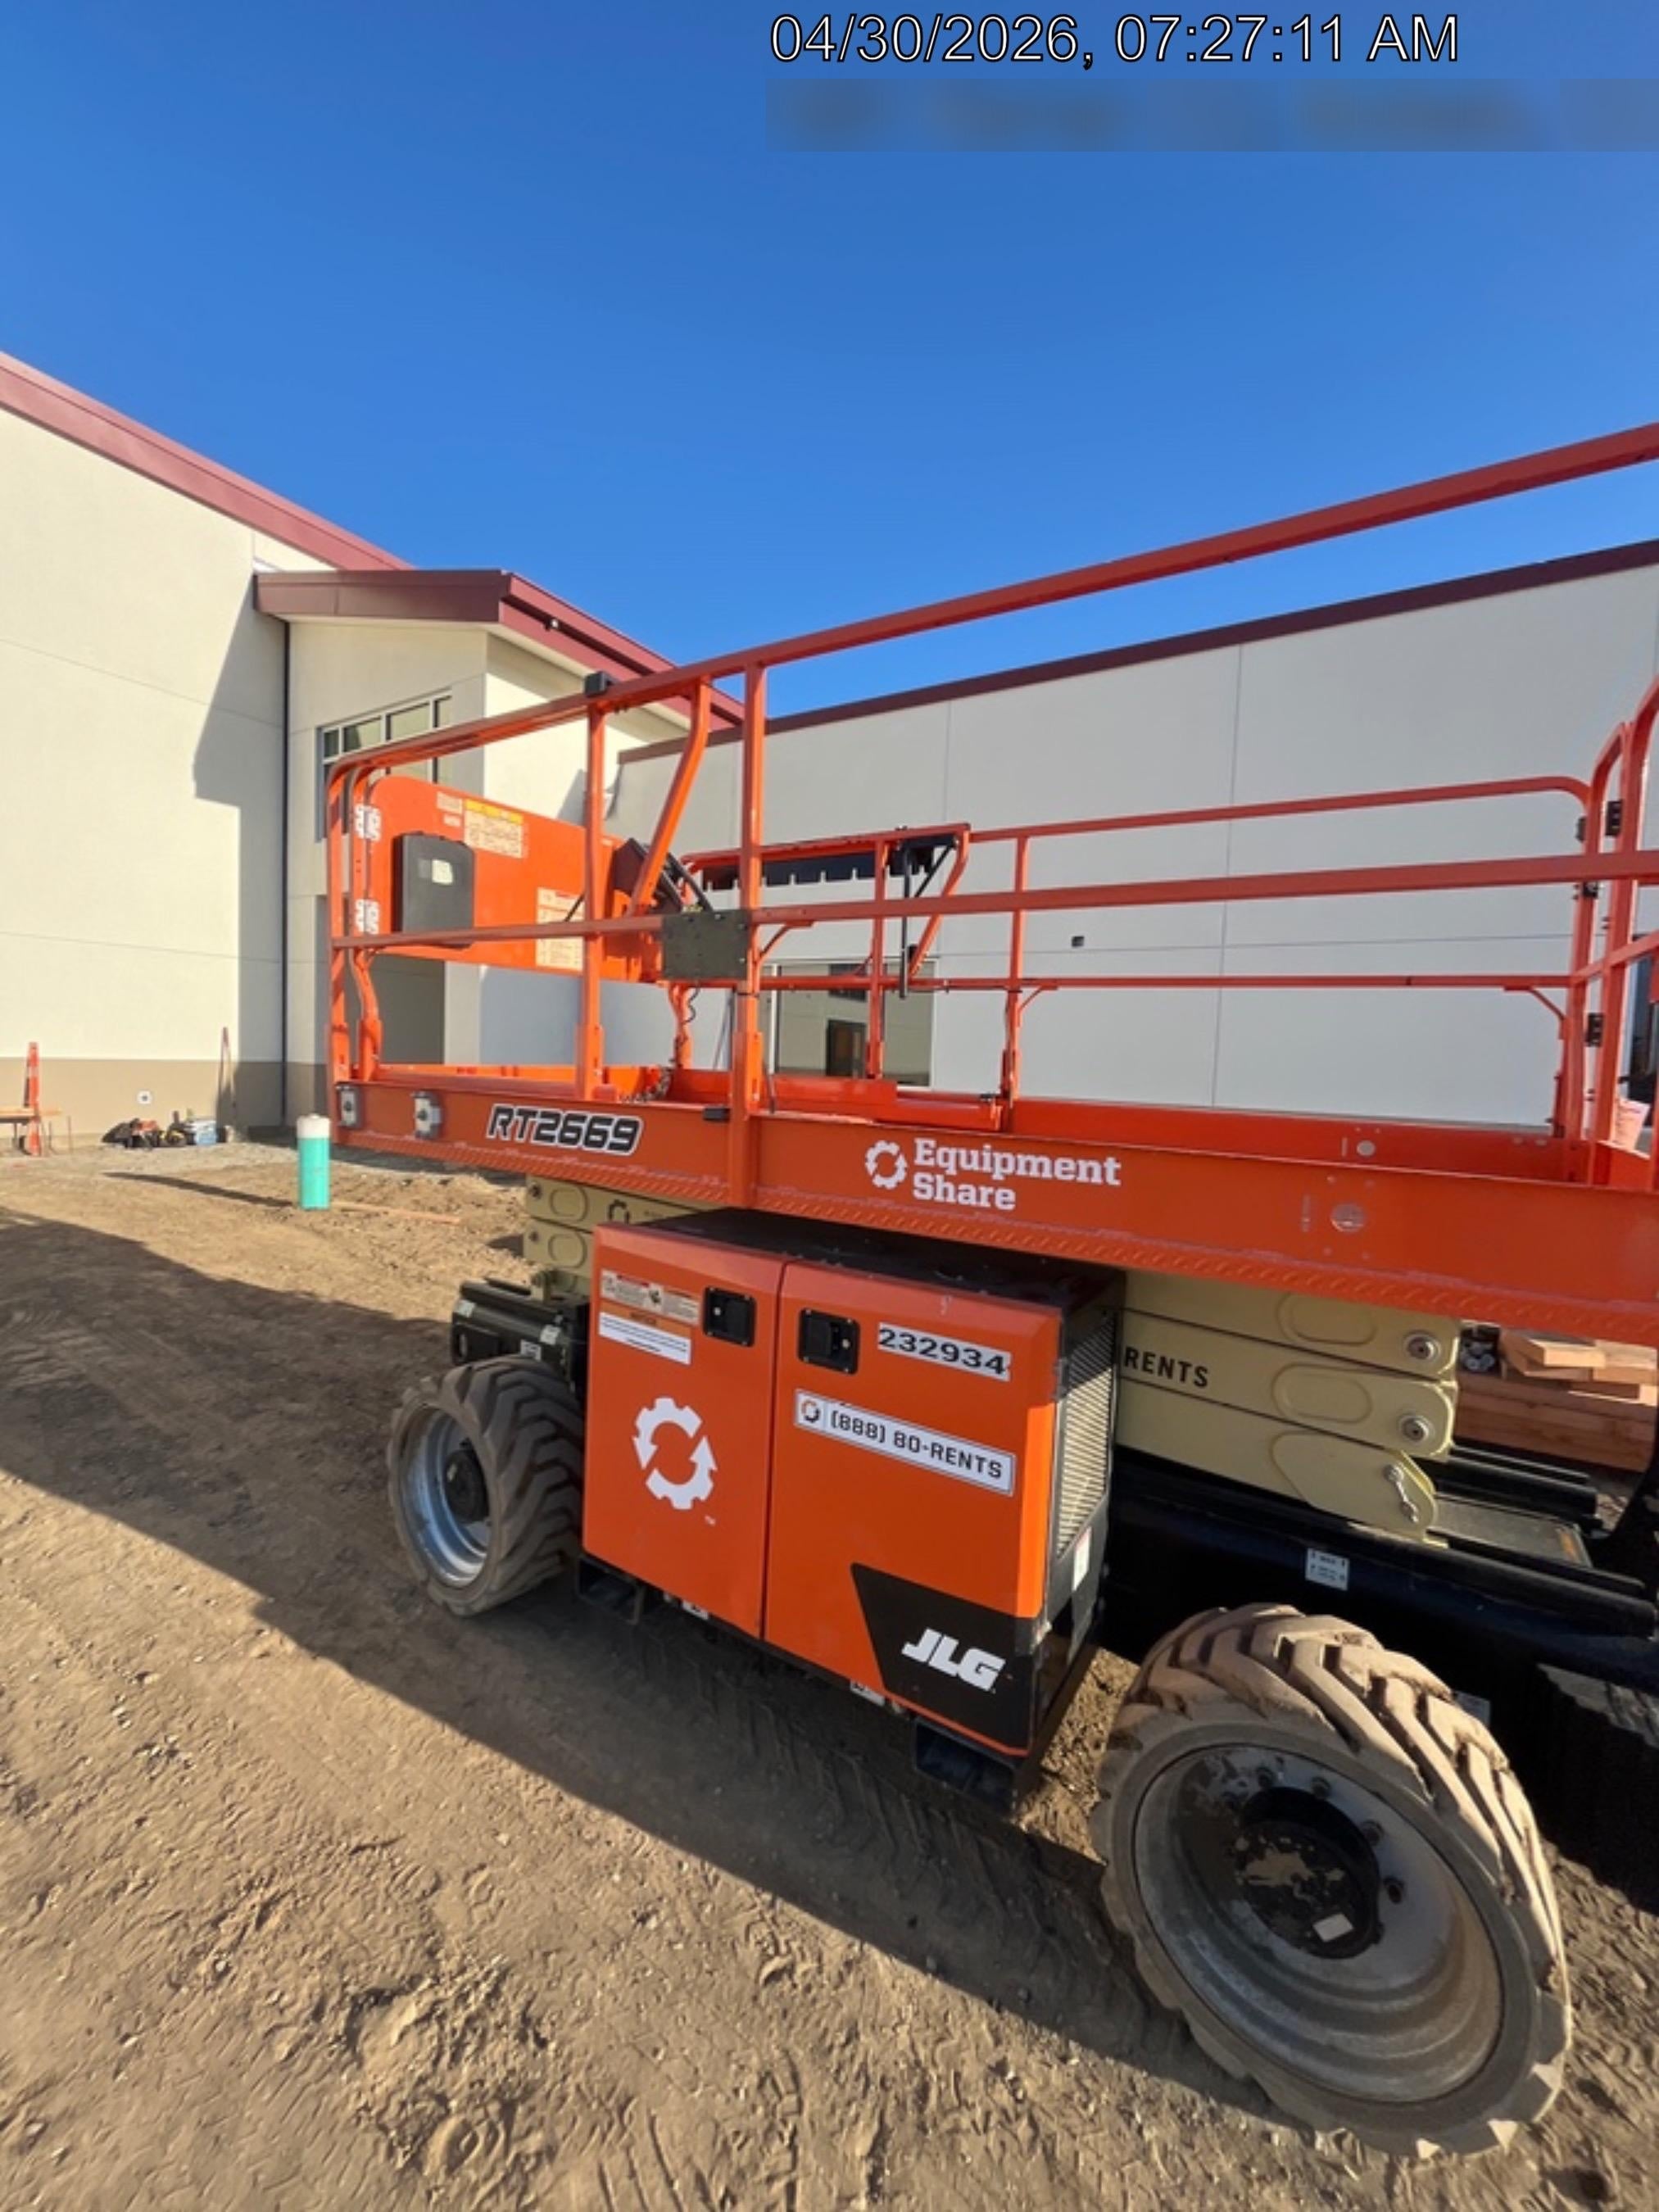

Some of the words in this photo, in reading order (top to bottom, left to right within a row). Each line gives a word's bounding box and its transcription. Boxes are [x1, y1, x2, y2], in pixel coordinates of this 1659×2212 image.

[487, 1105, 642, 1155] RT2669
[914, 1138, 1122, 1185] Equipment
[913, 1175, 1016, 1210] Share
[878, 1327, 1007, 1376] 232934
[1124, 1347, 1209, 1388] RENTS
[831, 1408, 886, 1444] (888)
[894, 1430, 1003, 1479] 80-RENTS
[902, 1628, 1006, 1692] JLG
